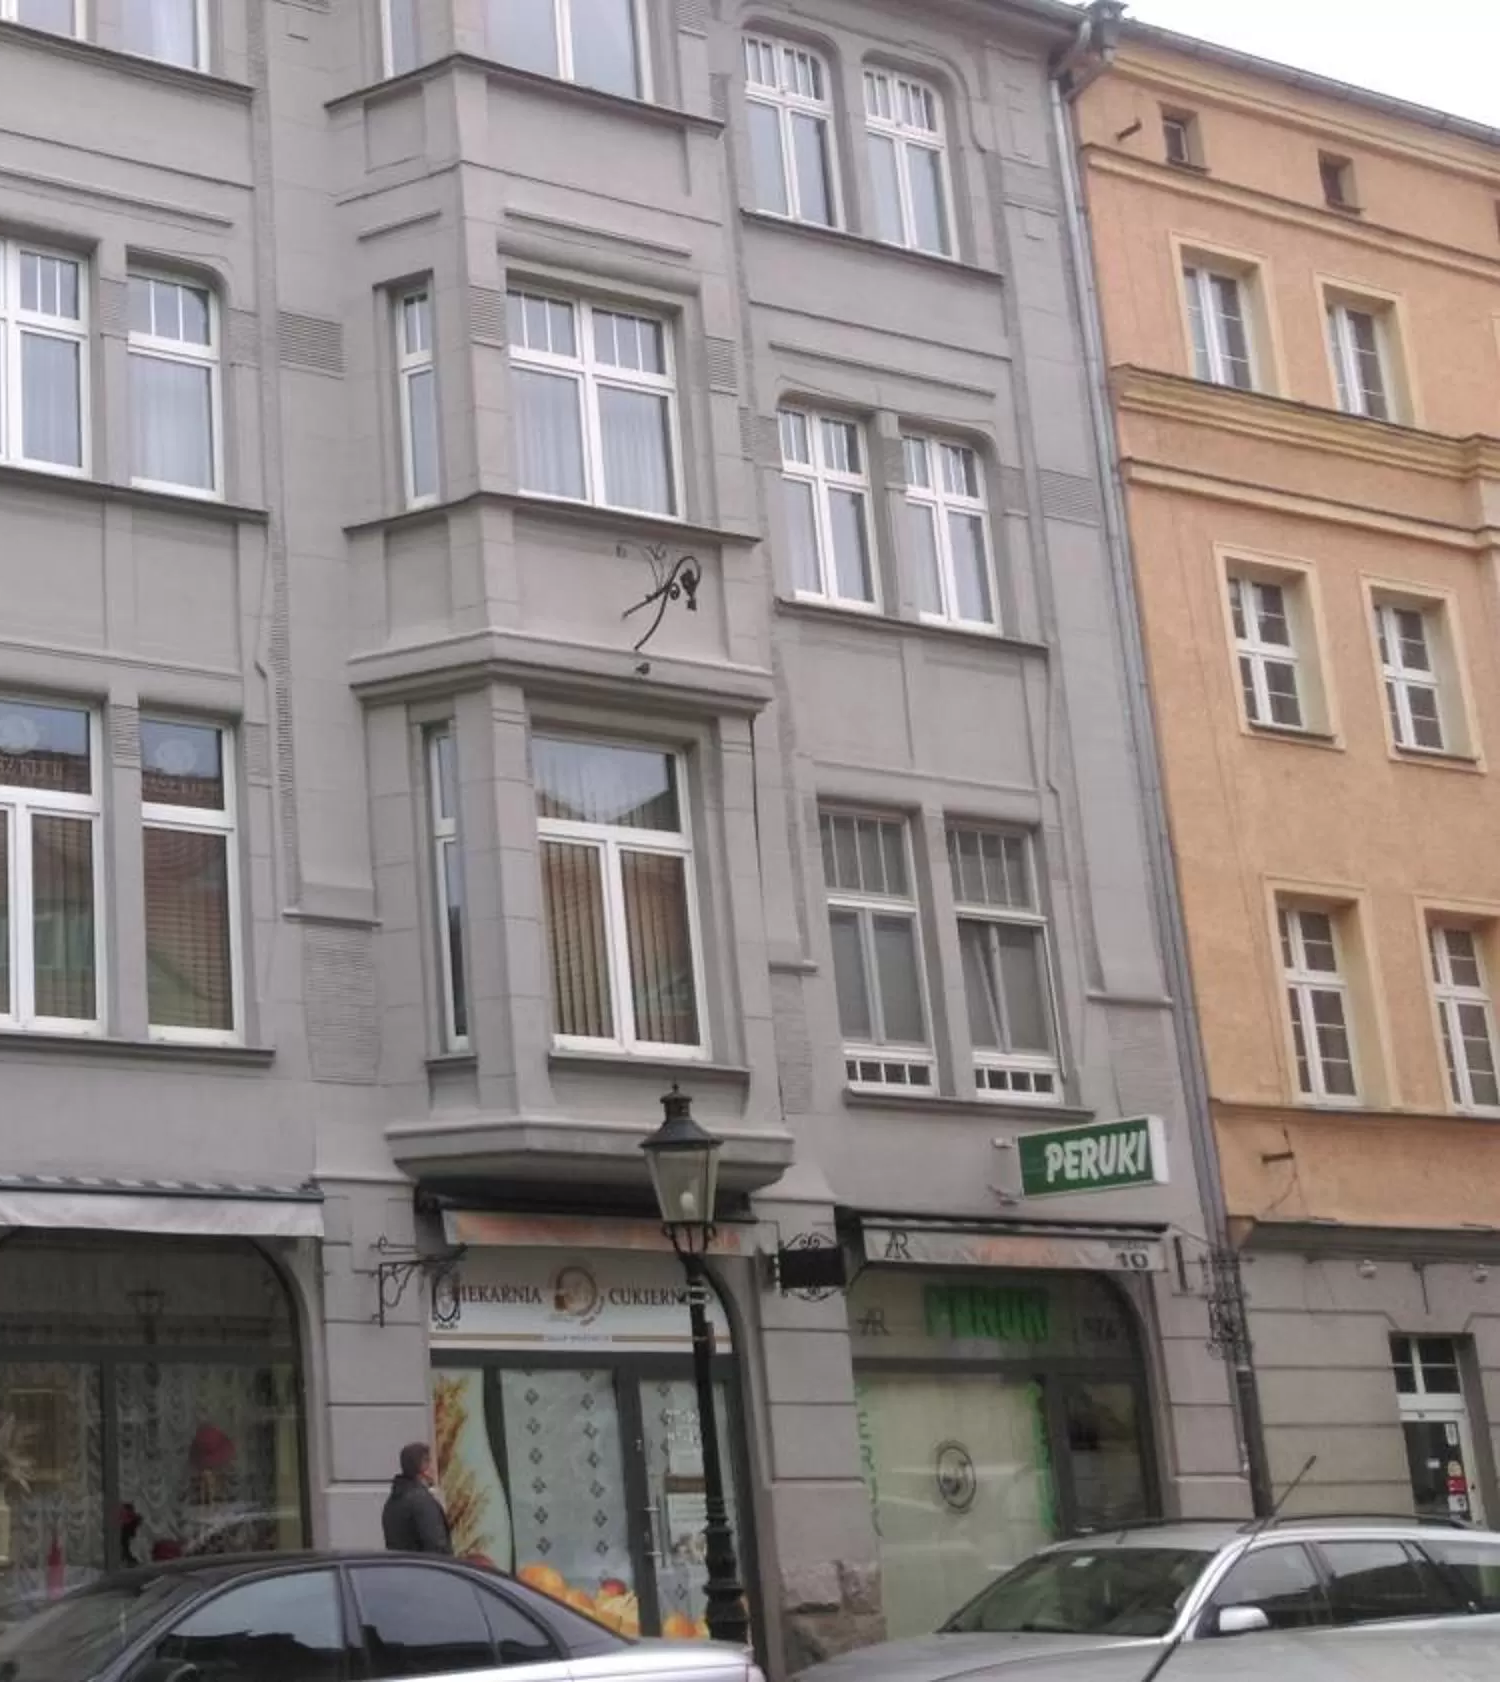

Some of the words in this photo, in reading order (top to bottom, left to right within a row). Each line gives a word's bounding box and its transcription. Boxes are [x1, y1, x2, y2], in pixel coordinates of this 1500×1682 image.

[1044, 1130, 1147, 1183] PERUKI
[1116, 1252, 1149, 1269] 10
[452, 1284, 543, 1305] IEKARNIA
[608, 1286, 695, 1306] CUKIERN
